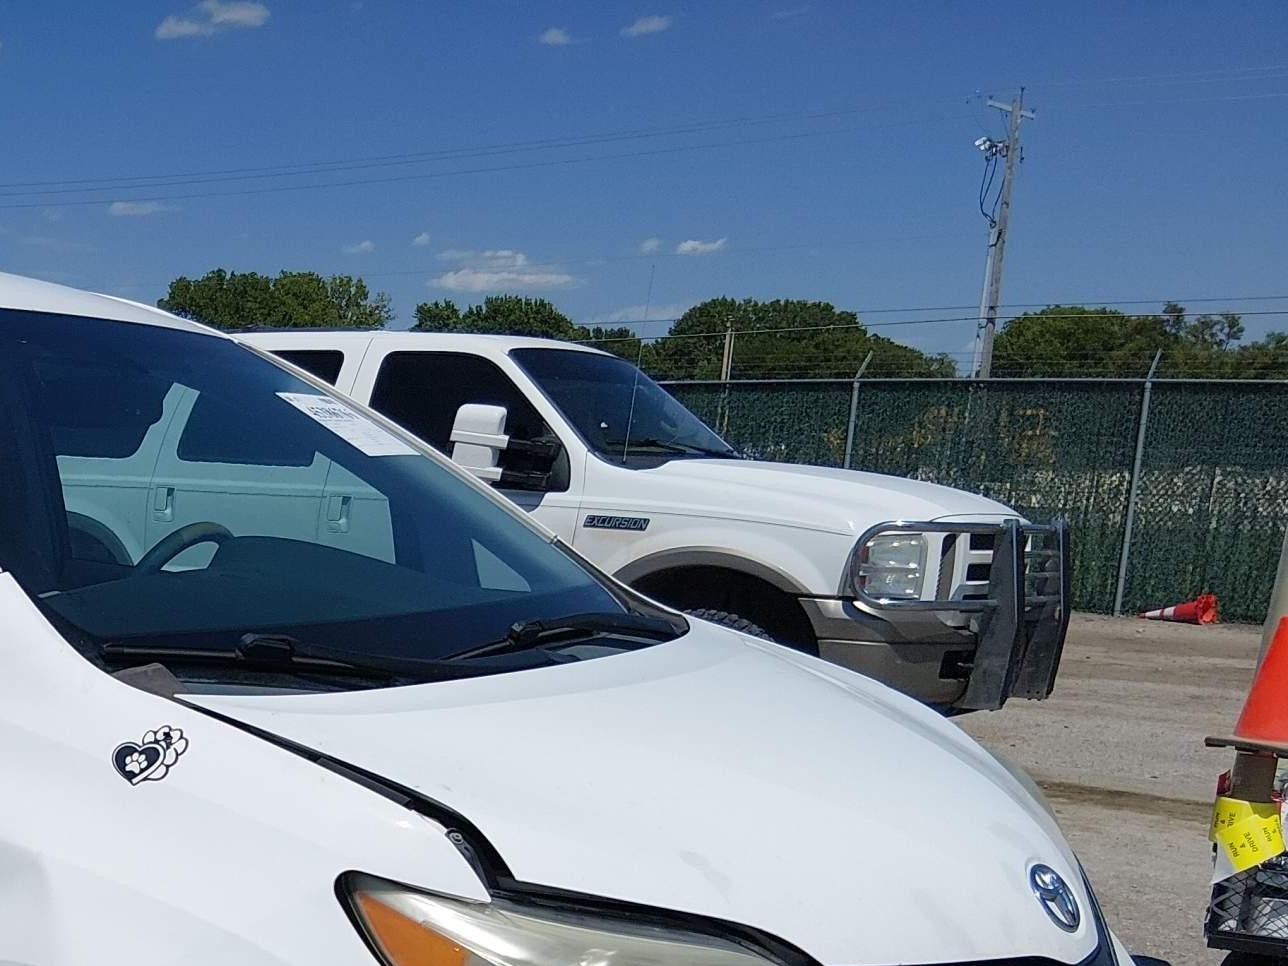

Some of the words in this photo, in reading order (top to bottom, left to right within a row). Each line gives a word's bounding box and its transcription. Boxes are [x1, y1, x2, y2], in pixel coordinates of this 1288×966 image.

[584, 515, 649, 529] EXCURSION
[1228, 842, 1240, 858] RUN
[1244, 832, 1259, 852] DRIVE
